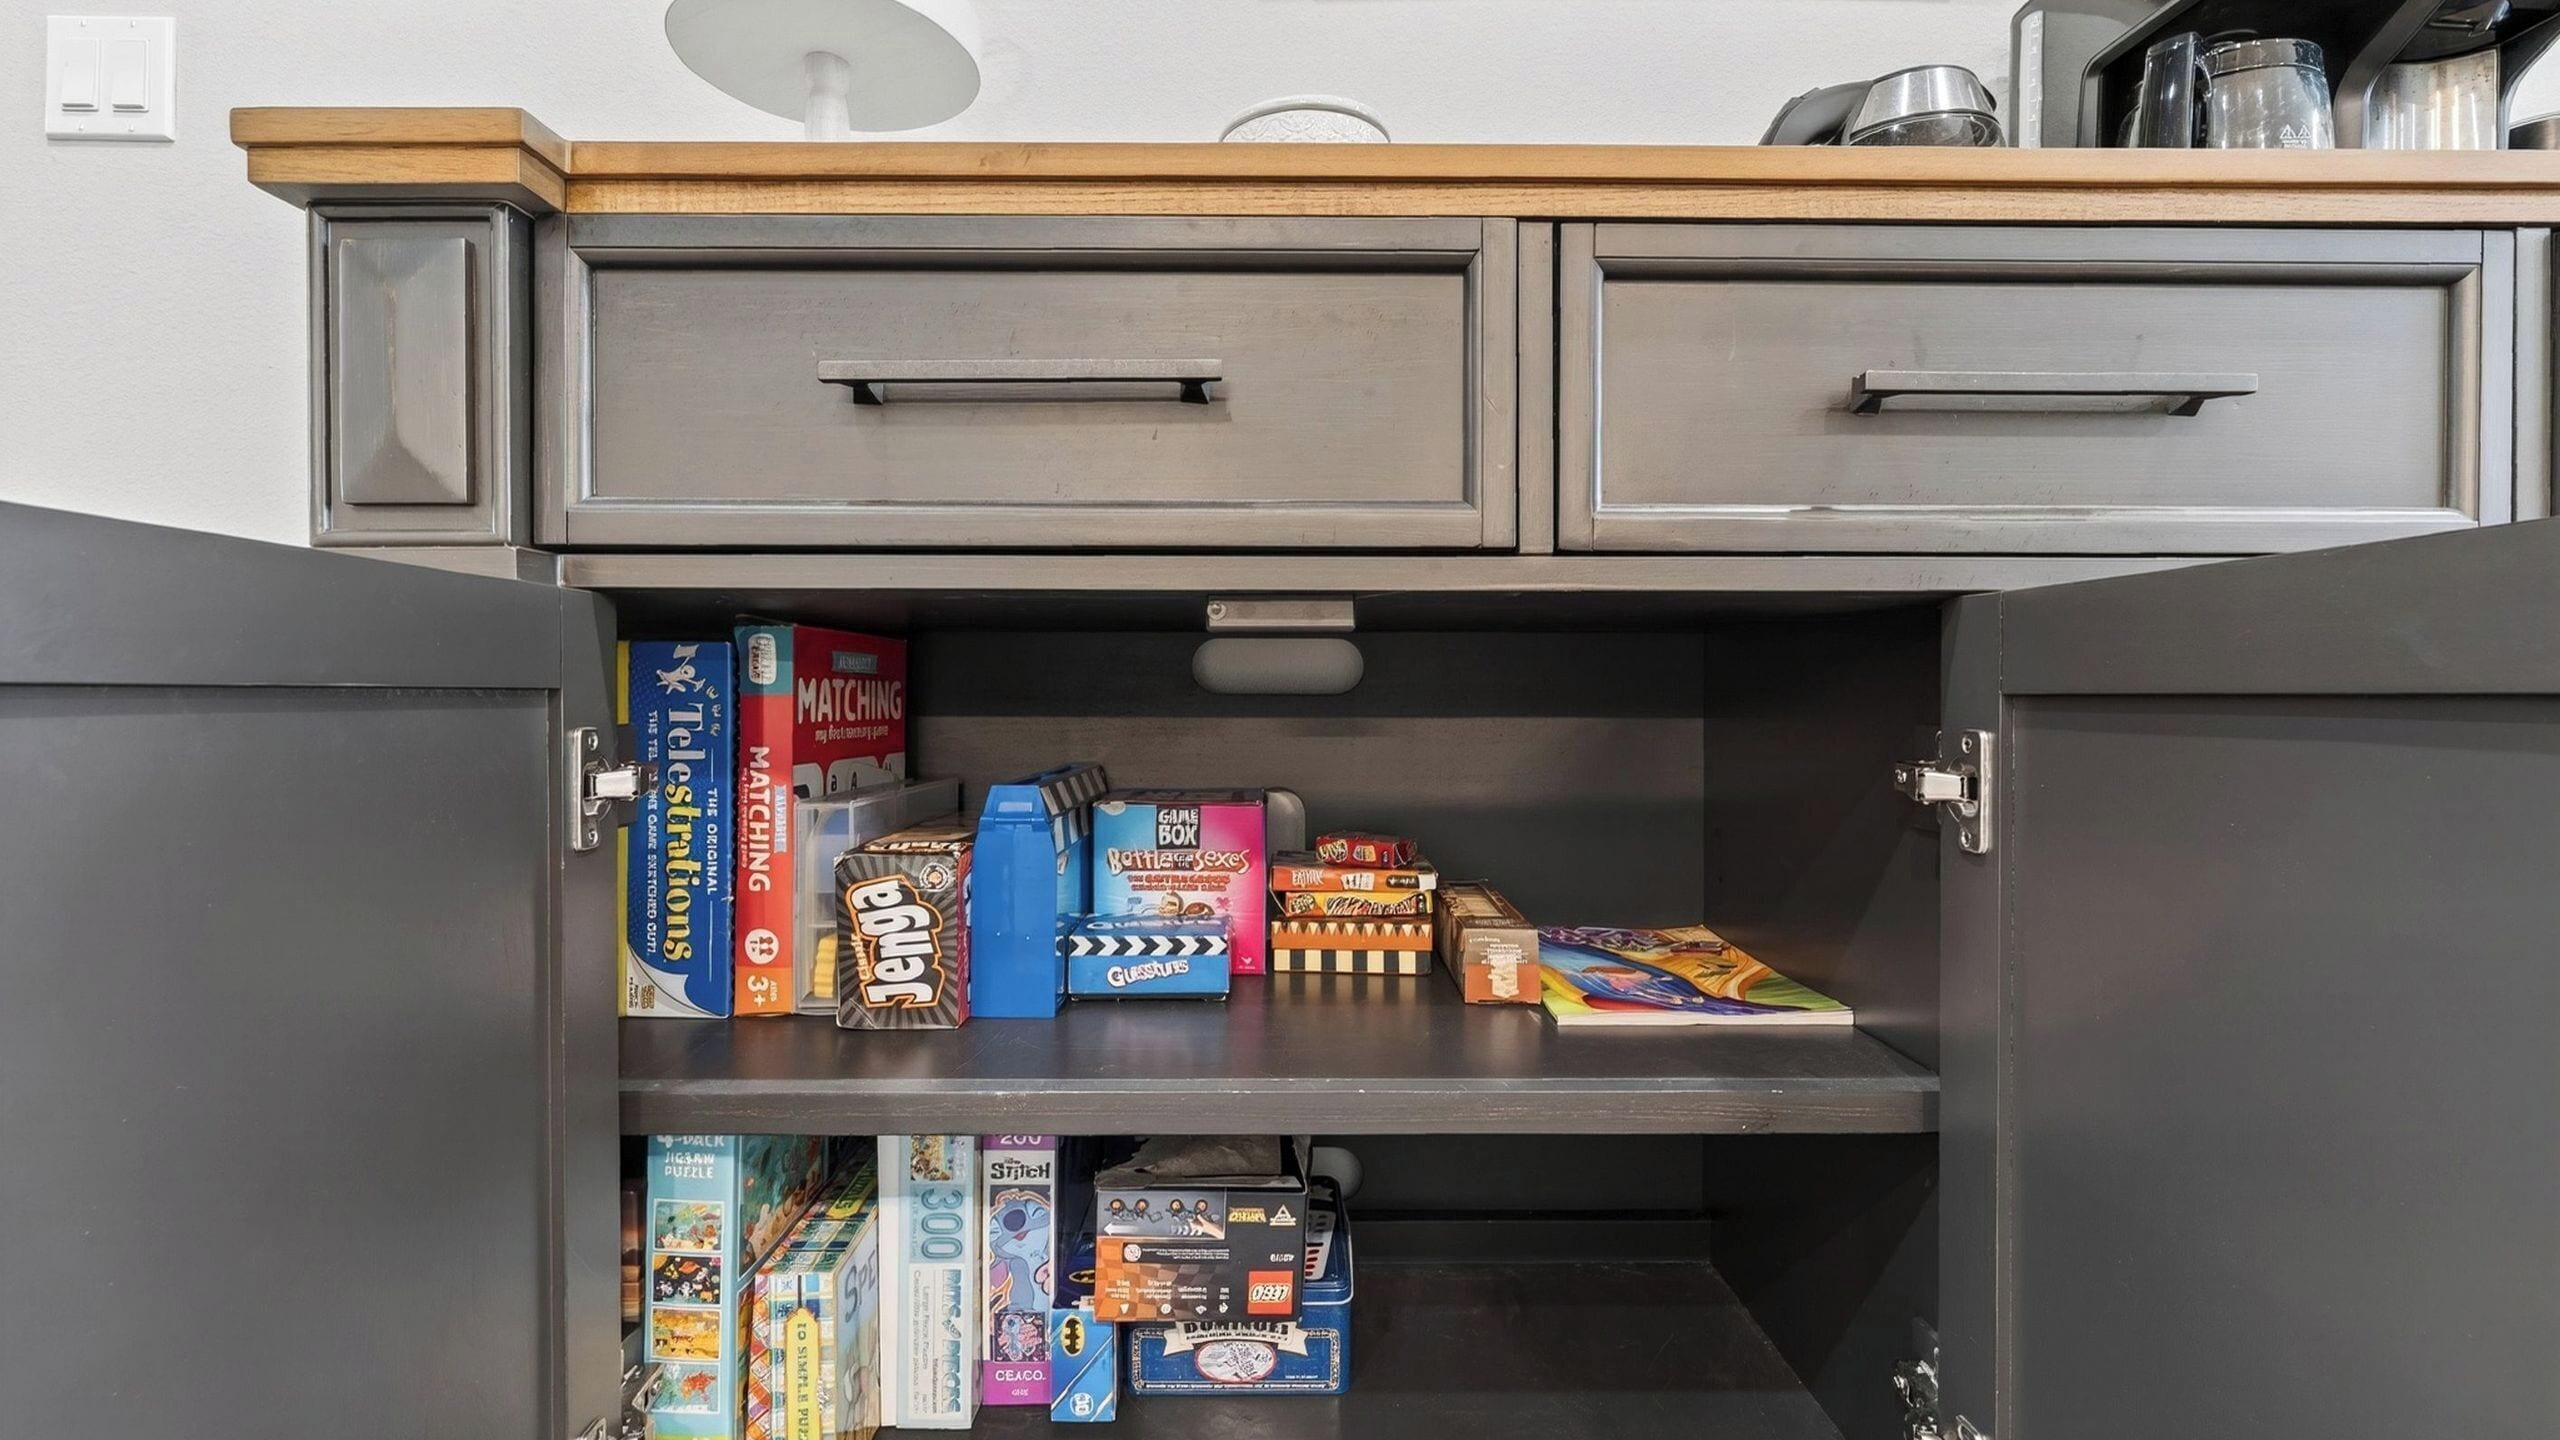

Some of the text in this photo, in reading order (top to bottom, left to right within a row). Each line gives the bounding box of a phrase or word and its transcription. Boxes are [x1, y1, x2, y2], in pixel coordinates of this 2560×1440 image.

[798, 677, 902, 725] MATCHING
[663, 702, 705, 962] Telestrations
[748, 746, 772, 893] MATCHING
[1158, 808, 1199, 825] GAME
[1158, 825, 1198, 845] BOX
[707, 823, 718, 896] ORIGINAL
[850, 881, 935, 1003] Jenga
[747, 974, 770, 1007] 3+
[664, 1152, 715, 1165] JIGSAW
[664, 1166, 715, 1179] PUZZLE
[921, 1188, 963, 1260] 300
[1249, 1283, 1291, 1304] LEGO
[797, 1345, 809, 1403] SIMPLE
